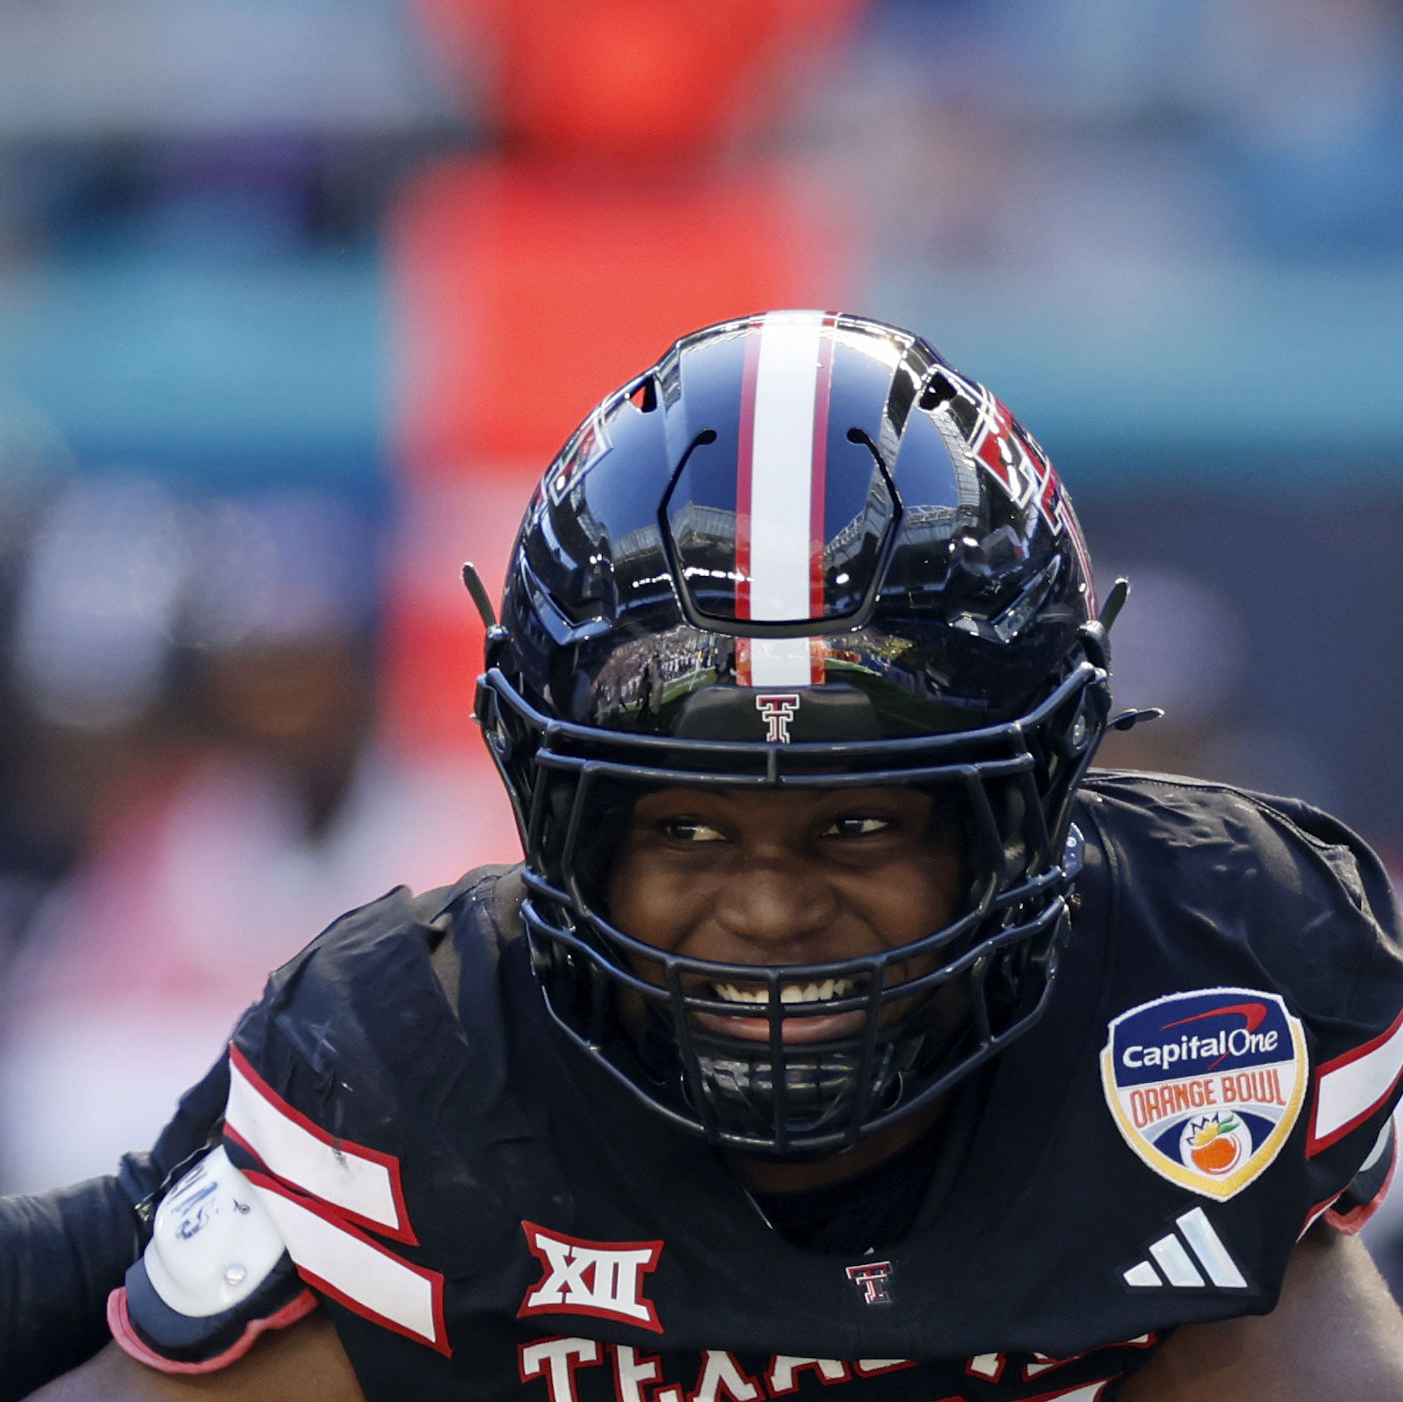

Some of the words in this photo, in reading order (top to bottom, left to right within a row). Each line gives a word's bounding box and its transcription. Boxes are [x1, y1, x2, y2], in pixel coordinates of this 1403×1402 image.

[1129, 1078, 1217, 1129] ORANGE
[1220, 1068, 1287, 1106] BOWL
[526, 1230, 655, 1324] XII
